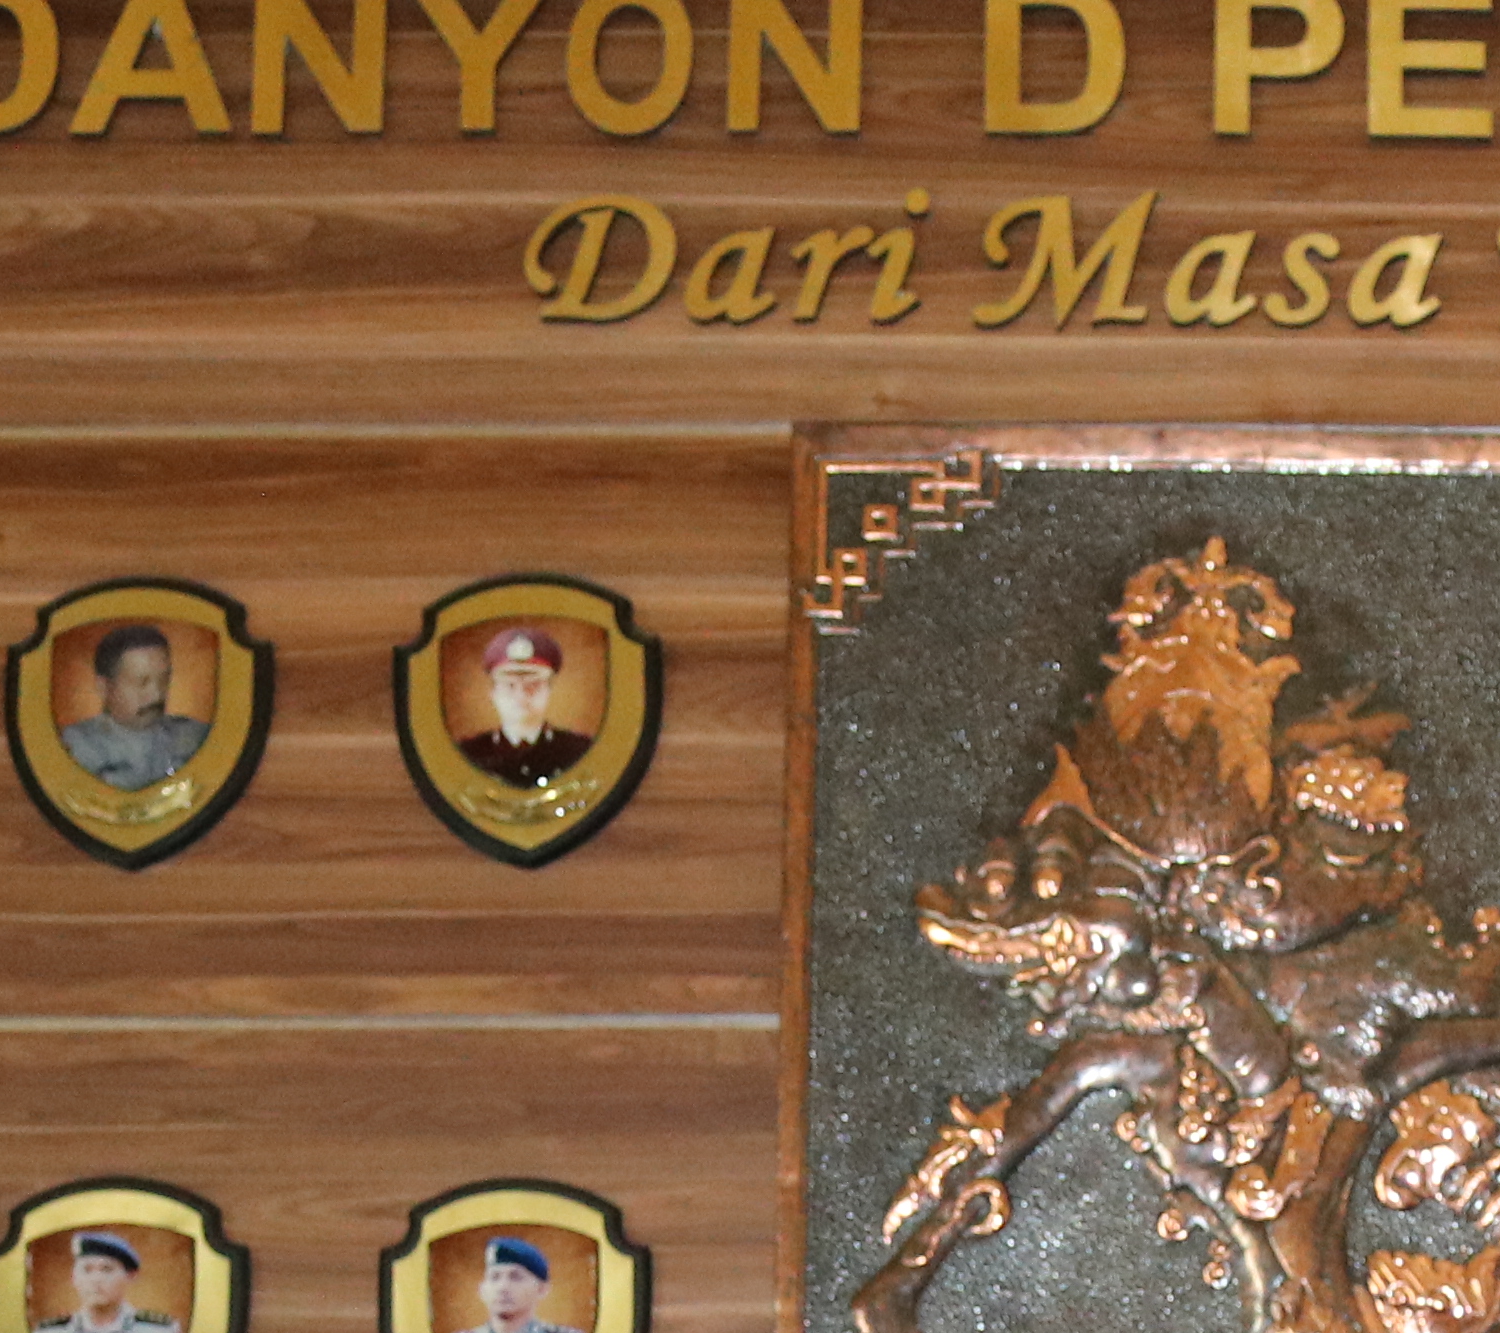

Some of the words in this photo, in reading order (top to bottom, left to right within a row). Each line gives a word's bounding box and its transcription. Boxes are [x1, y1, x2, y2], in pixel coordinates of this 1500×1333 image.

[983, 0, 1129, 136] D
[522, 187, 932, 326] Dari
[972, 190, 1444, 332] Masa
